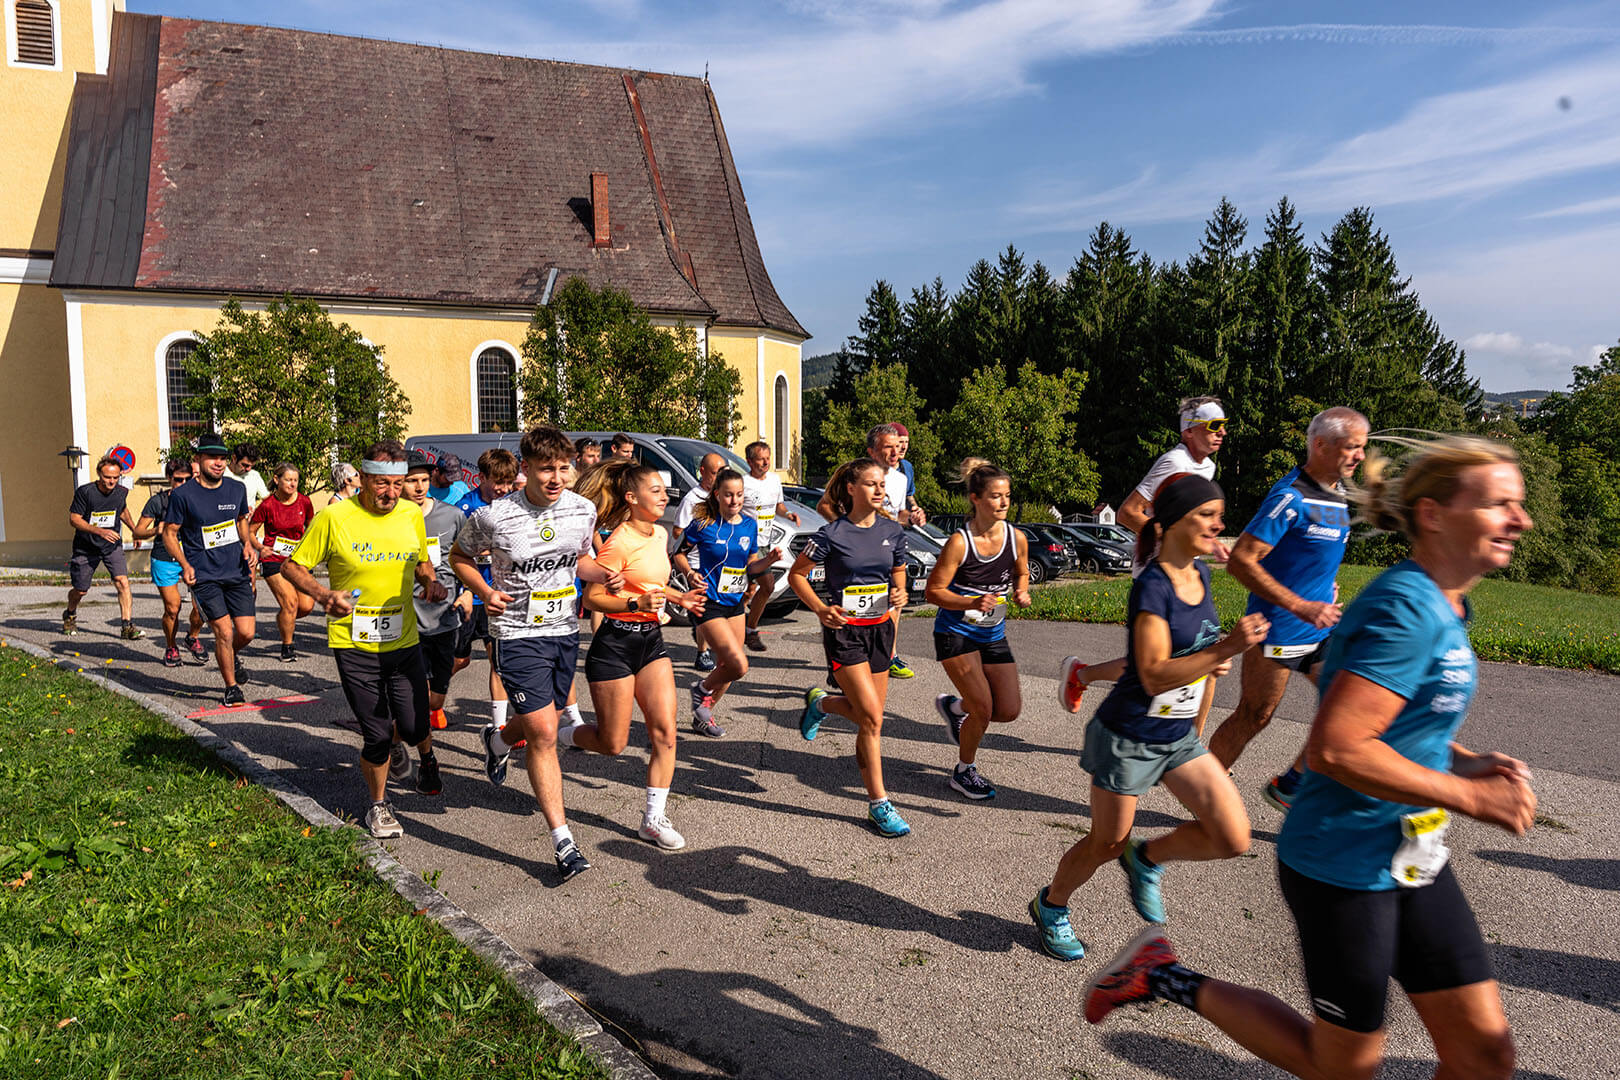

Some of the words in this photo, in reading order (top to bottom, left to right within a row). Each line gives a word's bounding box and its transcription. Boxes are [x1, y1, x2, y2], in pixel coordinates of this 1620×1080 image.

[214, 529, 227, 540] 37
[352, 542, 373, 552] RUN
[360, 552, 386, 563] YOUR
[388, 552, 416, 562] PACE
[546, 599, 562, 614] 31
[858, 595, 874, 609] 51
[371, 617, 391, 631] 15
[514, 692, 526, 703] 10
